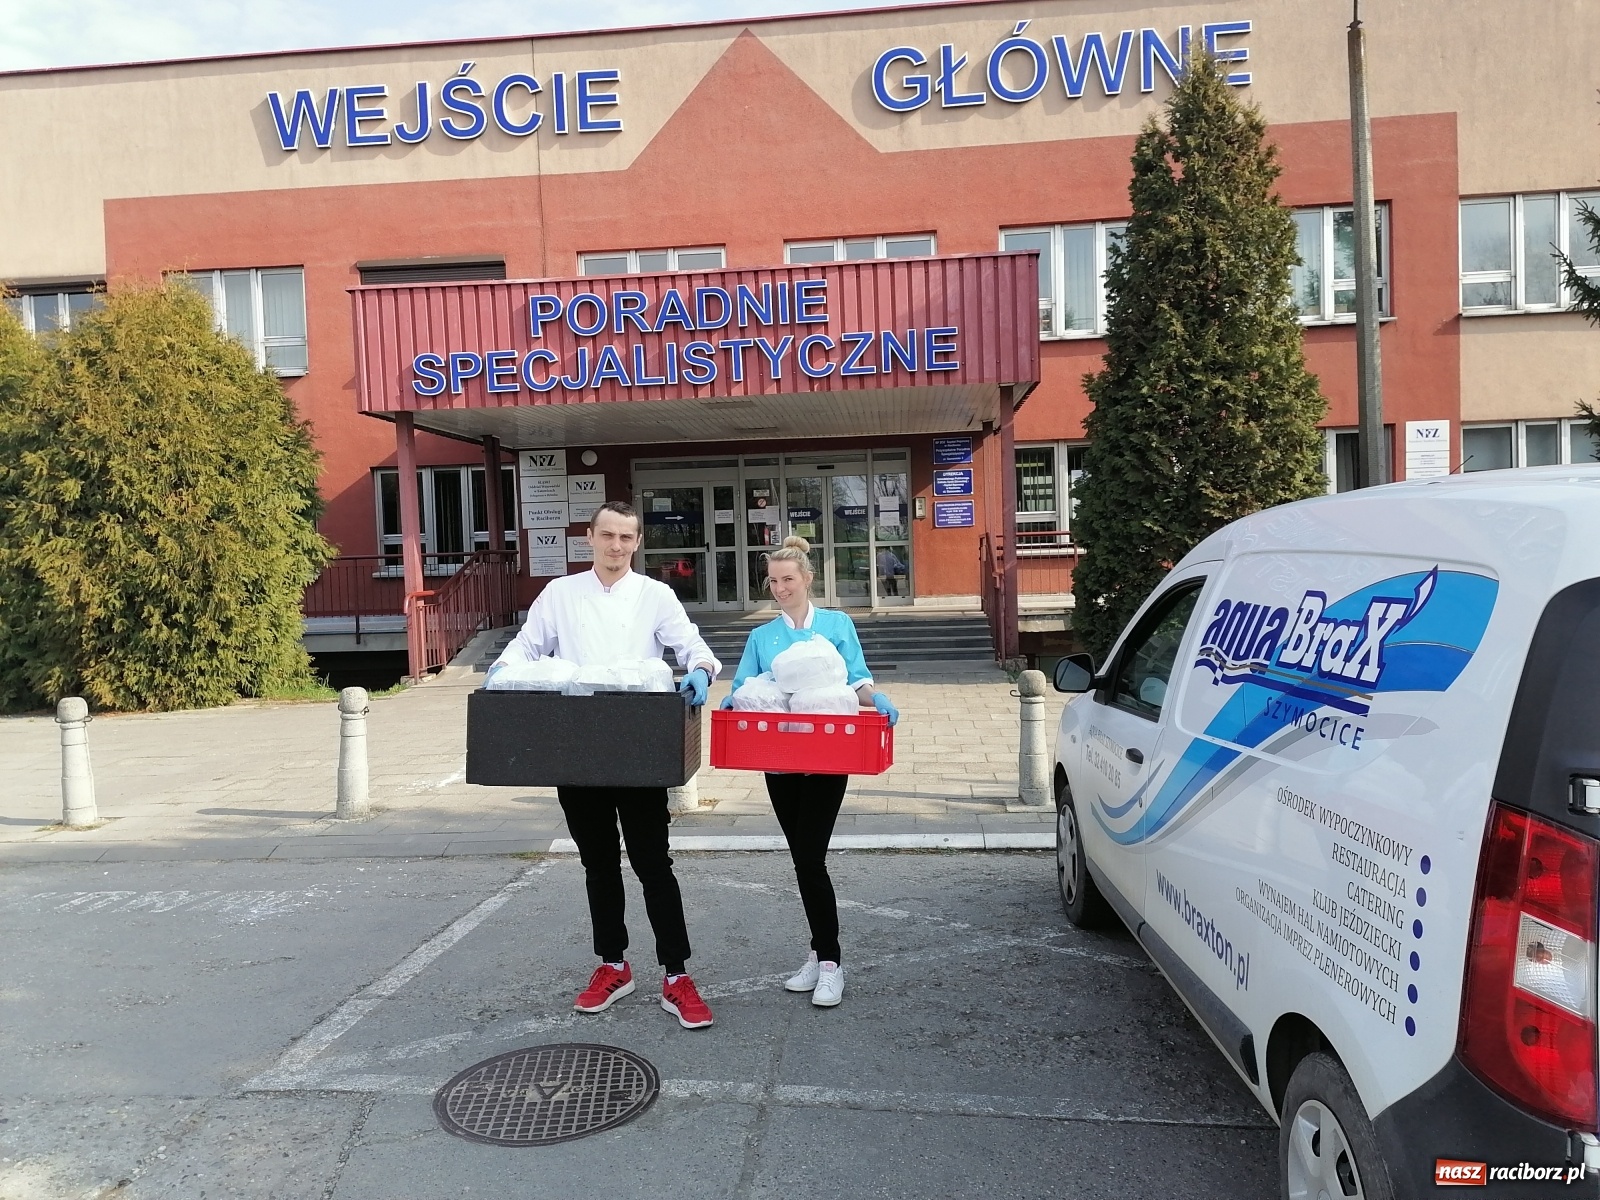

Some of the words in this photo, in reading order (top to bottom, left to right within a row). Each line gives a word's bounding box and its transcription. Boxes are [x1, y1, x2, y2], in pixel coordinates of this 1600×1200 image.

[266, 60, 624, 151] WEJŚCIE
[871, 19, 1252, 112] GŁÓWNE
[529, 278, 829, 338] PORADNIE
[412, 325, 961, 396] SPECJALISTYCZNE
[528, 454, 556, 467] NFZ
[1264, 696, 1365, 751] SZYMOCICE
[1277, 785, 1317, 820] OŚRODEK
[1319, 806, 1413, 866] WYPOCZYNKOWY
[1332, 842, 1407, 899] RESTAURACJA
[1347, 881, 1404, 930] CATERING
[1156, 868, 1250, 991] www.braxton.pl
[1235, 886, 1282, 936] ORGANIZACJA
[1283, 922, 1314, 960] IMPREZ
[1314, 947, 1397, 1025] PLENEROWYCH
[1258, 879, 1296, 919] WYNAJEM
[1298, 907, 1315, 934] HAL
[1316, 922, 1399, 993] NAMIOTOWYCH
[1313, 888, 1337, 919] KLUB
[1339, 908, 1402, 962] JEŹDZIECKI
